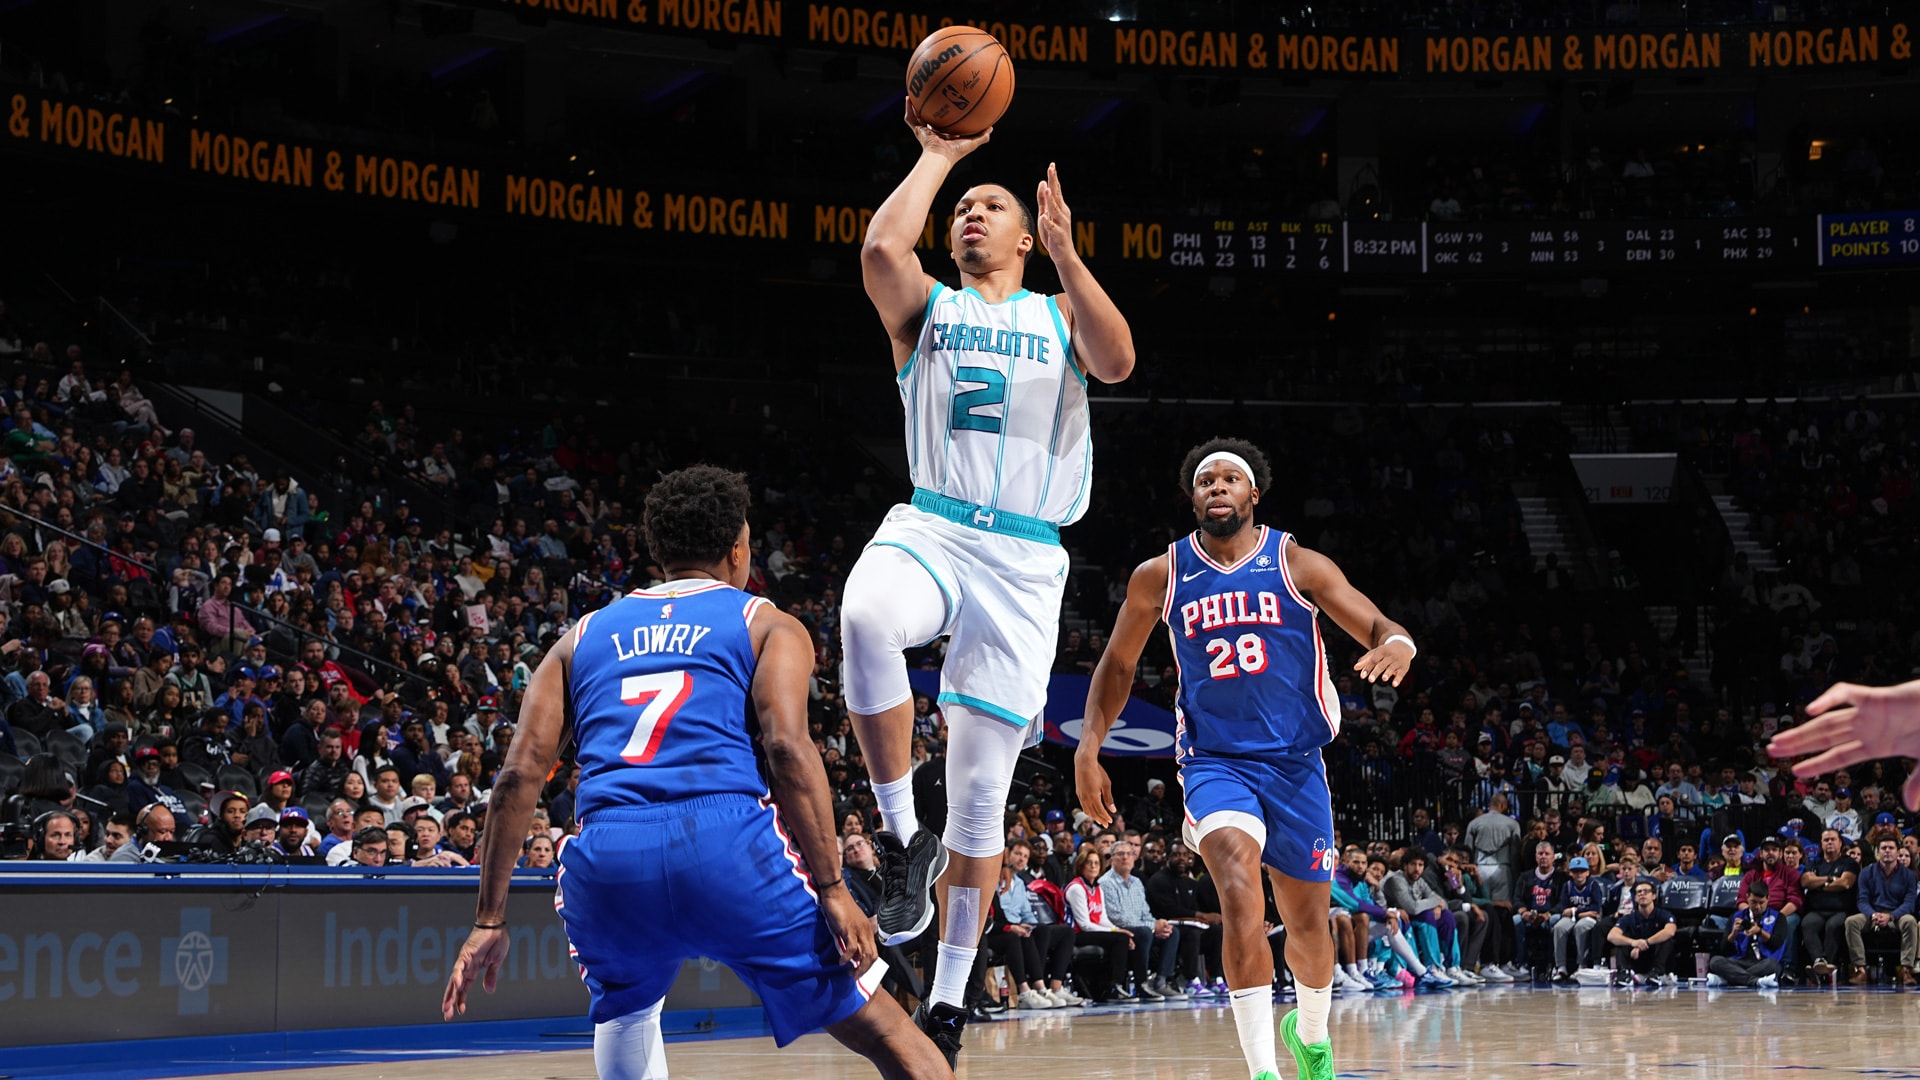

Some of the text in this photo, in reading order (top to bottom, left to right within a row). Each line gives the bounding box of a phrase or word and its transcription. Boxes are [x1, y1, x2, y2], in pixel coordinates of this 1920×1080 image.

[658, 0, 781, 36] MORGAN
[809, 5, 1088, 63] MORGAN ORGAN
[1749, 23, 1911, 67] MORGAN &
[1115, 28, 1398, 72] MORGAN & MORGAN
[1426, 32, 1720, 72] MORGAN & MORGAN
[909, 43, 964, 98] Wilson
[9, 94, 164, 163] & MORGAN
[191, 129, 479, 208] MORGAN & MORGAN
[506, 175, 788, 239] MORGAN & MORGAN
[1213, 220, 1334, 235] REB AST BLK STL
[1434, 232, 1484, 244] GSW 79
[1529, 231, 1554, 243] MIA
[1626, 229, 1675, 241] DAL 23
[1722, 226, 1772, 239] SAC 33
[1829, 218, 1915, 237] PLAYER 8
[1173, 233, 1328, 251] PHI 17 13 1 7
[1353, 240, 1417, 255] 8:32 PM
[1626, 248, 1676, 261] DEN 30
[1722, 247, 1773, 260] PHX 29
[1831, 241, 1890, 257] POINTS
[1169, 251, 1330, 269] CHA 23 11 2 6
[1434, 252, 1483, 264] OKC 62
[1530, 250, 1555, 262] MIN
[931, 323, 1050, 365] CHARLOTTE
[952, 365, 1007, 434] 2
[1181, 591, 1283, 639] PHILA
[611, 623, 711, 662] LOWRY
[1205, 632, 1269, 681] 28
[620, 669, 694, 765] 7
[1671, 880, 1691, 890] NJM
